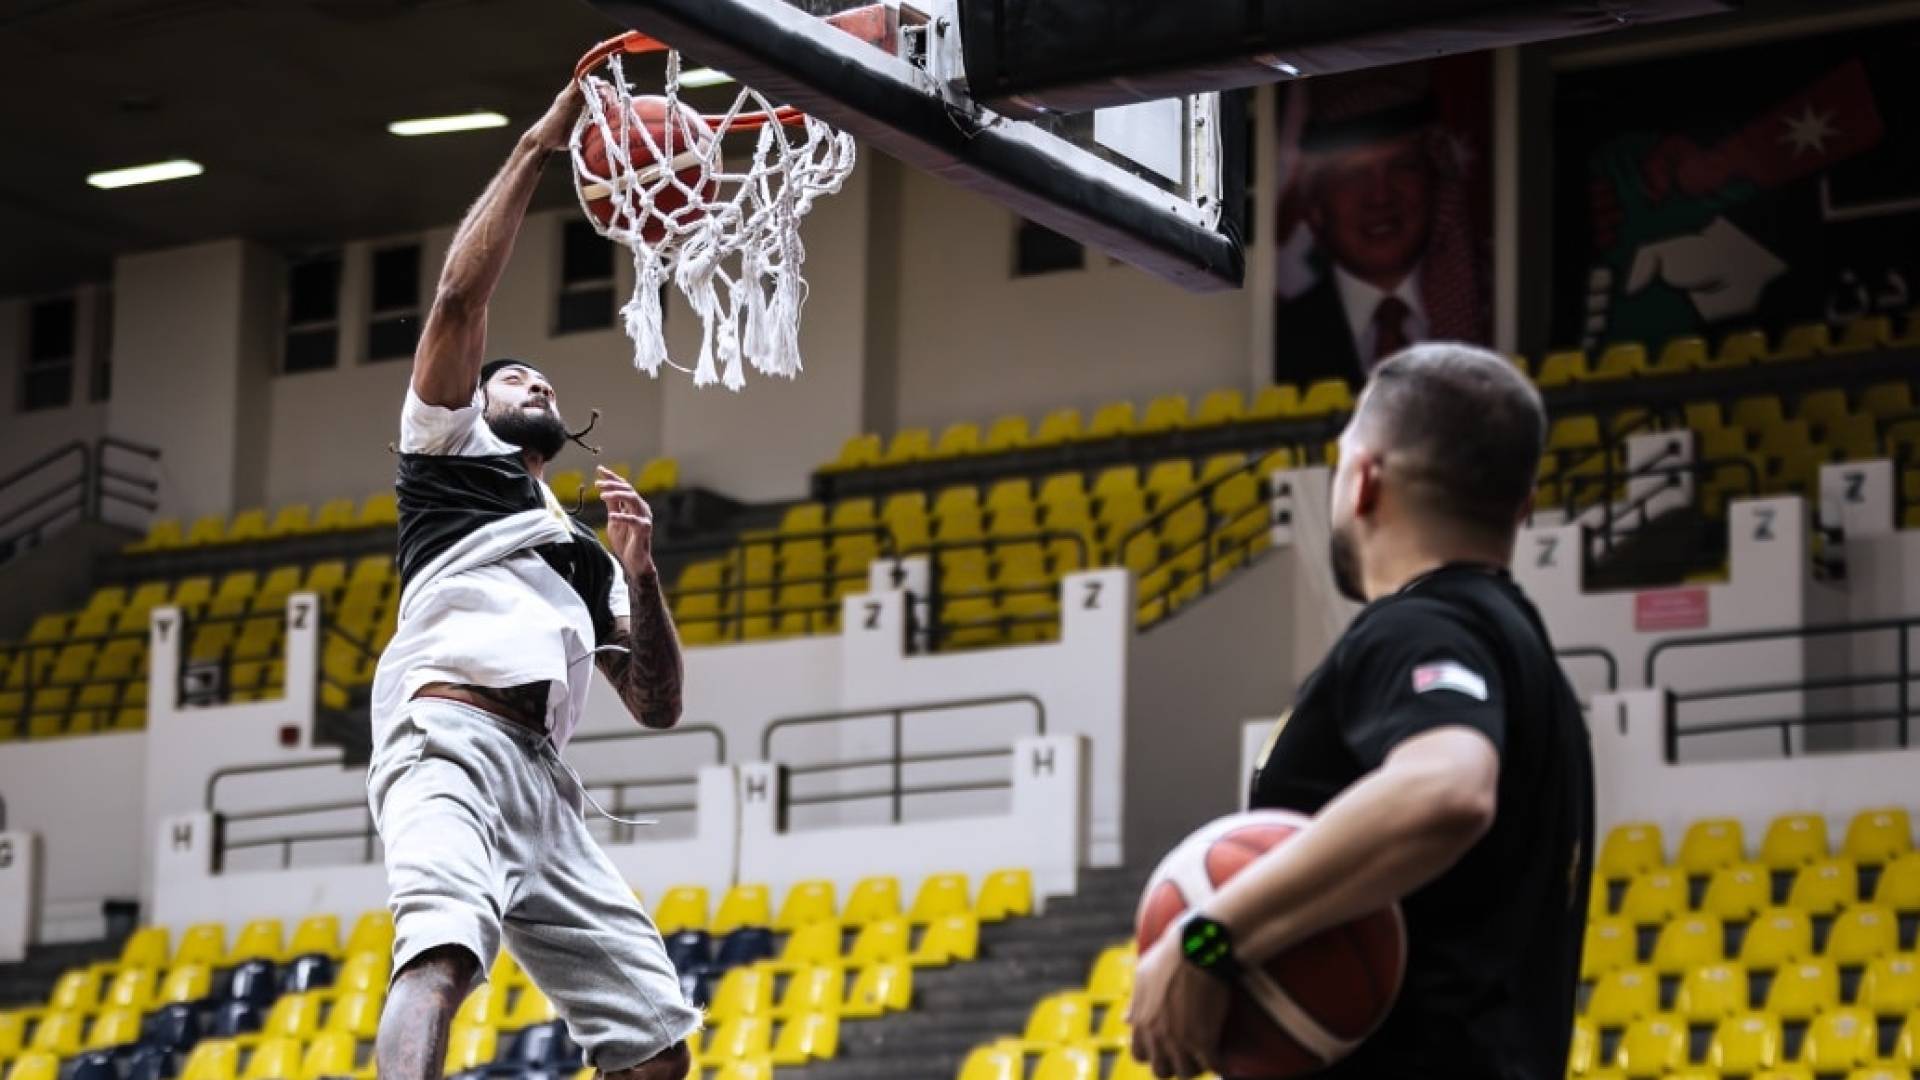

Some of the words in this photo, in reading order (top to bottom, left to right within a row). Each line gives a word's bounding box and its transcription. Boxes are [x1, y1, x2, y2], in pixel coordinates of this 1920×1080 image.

[1843, 472, 1865, 503] Z
[1753, 508, 1775, 541] Z
[1536, 537, 1558, 567] Z
[1083, 582, 1102, 610] Z
[294, 604, 309, 630] Z
[863, 602, 881, 630] Z
[1033, 746, 1053, 776] H
[747, 775, 767, 802] H
[173, 825, 192, 852] H
